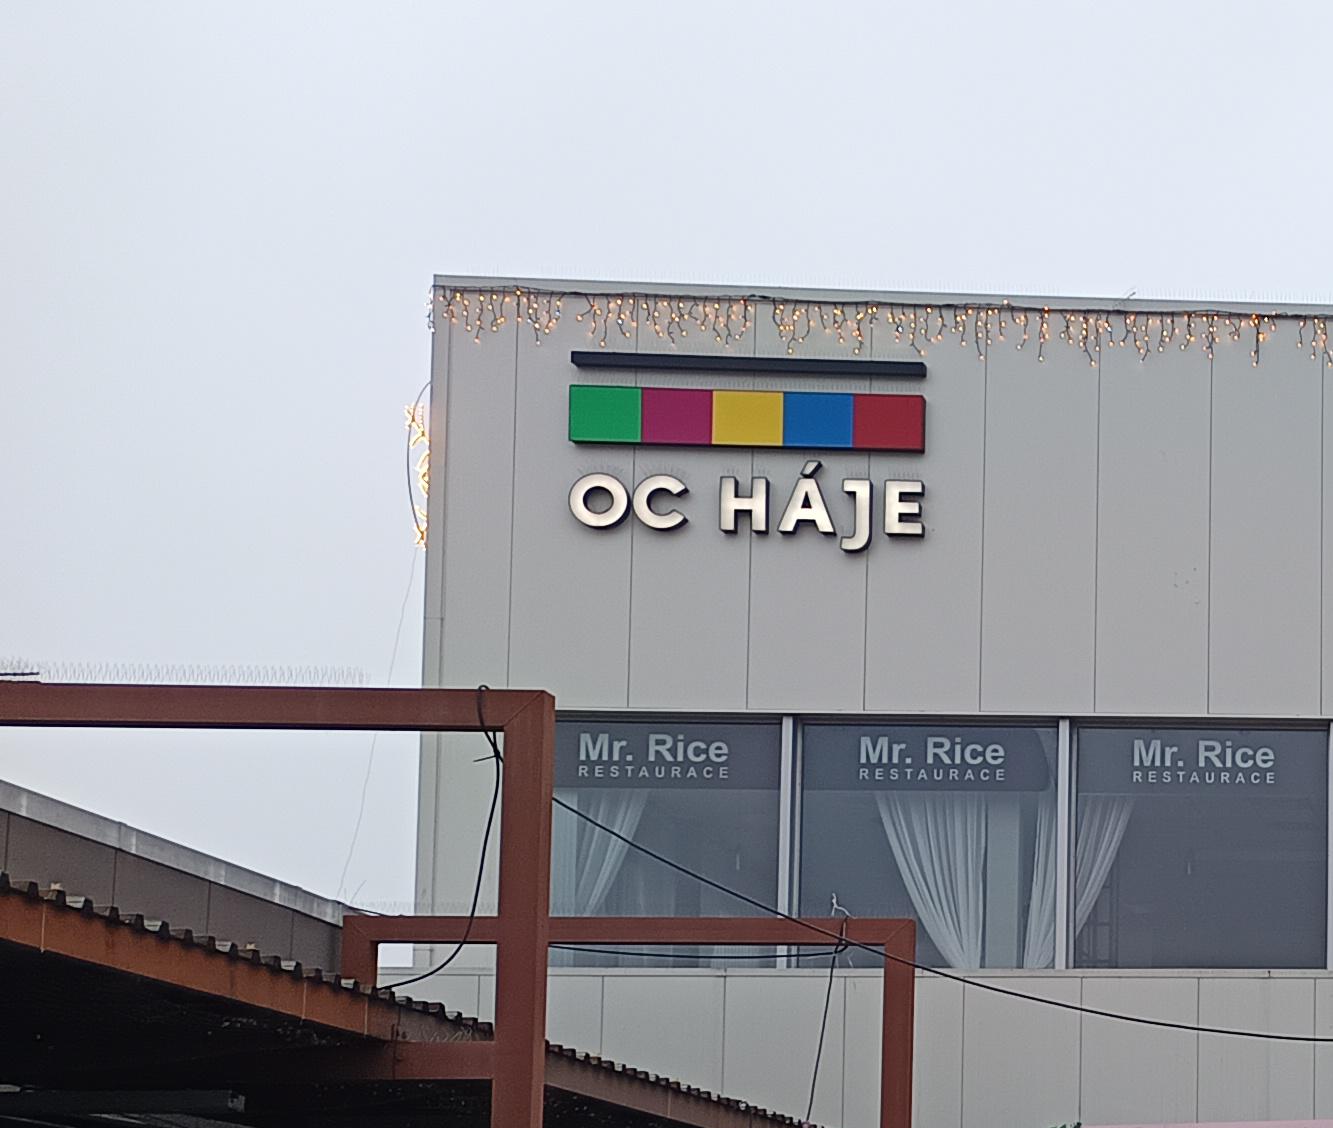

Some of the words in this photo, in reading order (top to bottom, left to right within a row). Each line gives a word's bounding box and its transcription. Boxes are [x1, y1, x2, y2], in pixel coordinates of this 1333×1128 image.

[567, 471, 690, 532] OC
[718, 460, 926, 554] HÁJE
[578, 732, 635, 762] Mr.
[647, 732, 730, 763] Rice
[858, 735, 914, 765] Mr.
[925, 736, 1006, 766] Rice
[1132, 739, 1185, 768] Mr.
[1197, 739, 1275, 769] Rice
[578, 764, 730, 779] RESTAURACE
[858, 767, 1006, 781] RESTAURACE
[1132, 770, 1276, 785] RESTAURACE
